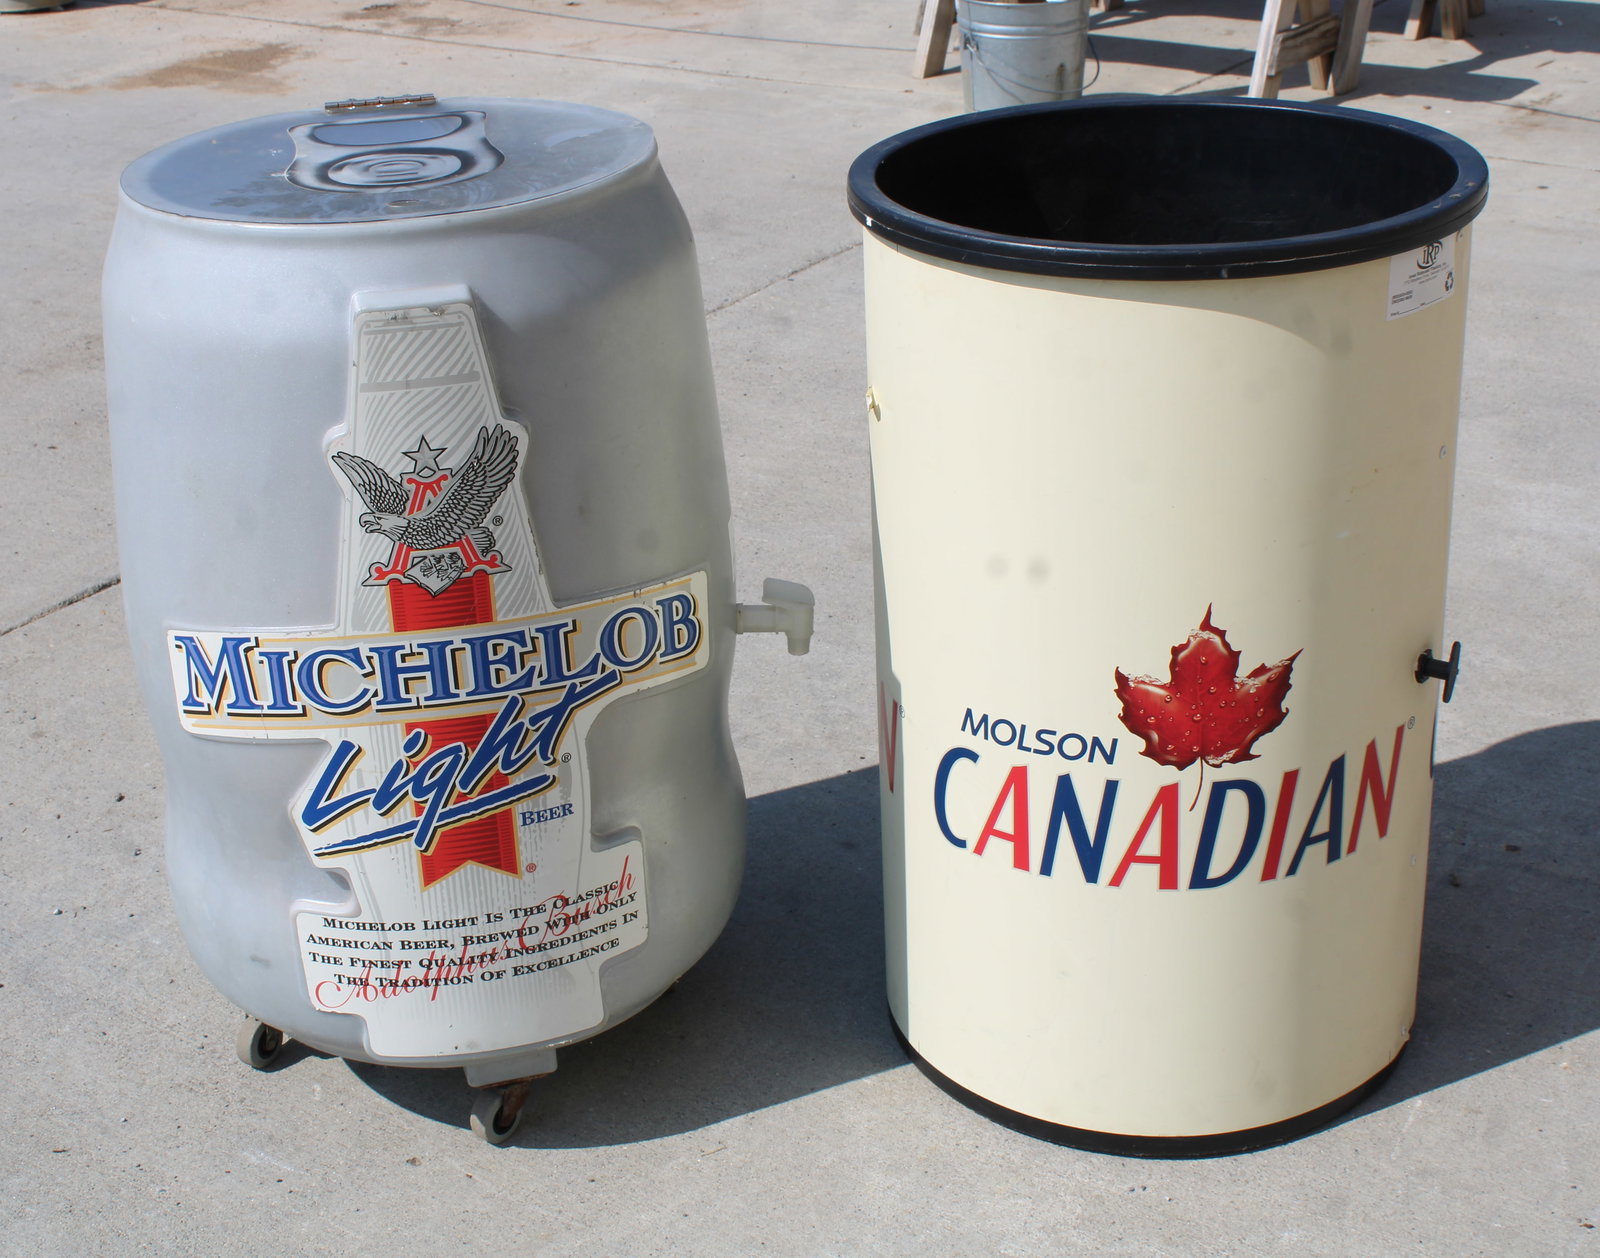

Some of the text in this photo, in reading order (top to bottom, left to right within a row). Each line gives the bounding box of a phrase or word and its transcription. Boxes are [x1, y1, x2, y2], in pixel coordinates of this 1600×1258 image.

[175, 590, 702, 719] MICHELOB
[299, 668, 622, 855] Light
[960, 707, 1119, 765] MOLSON
[520, 802, 575, 828] BEER
[933, 722, 1406, 892] CANADIAN
[306, 891, 638, 950] AMERICAN BEER, BREWED WITH ONLY
[322, 881, 619, 932] MICHELOB LIGHT IS THE CLASSIC
[308, 910, 639, 970] THE FINEST QUALITY INGREDIENTS IN
[334, 937, 620, 988] THE TRADITION OF EXCELLENCE
